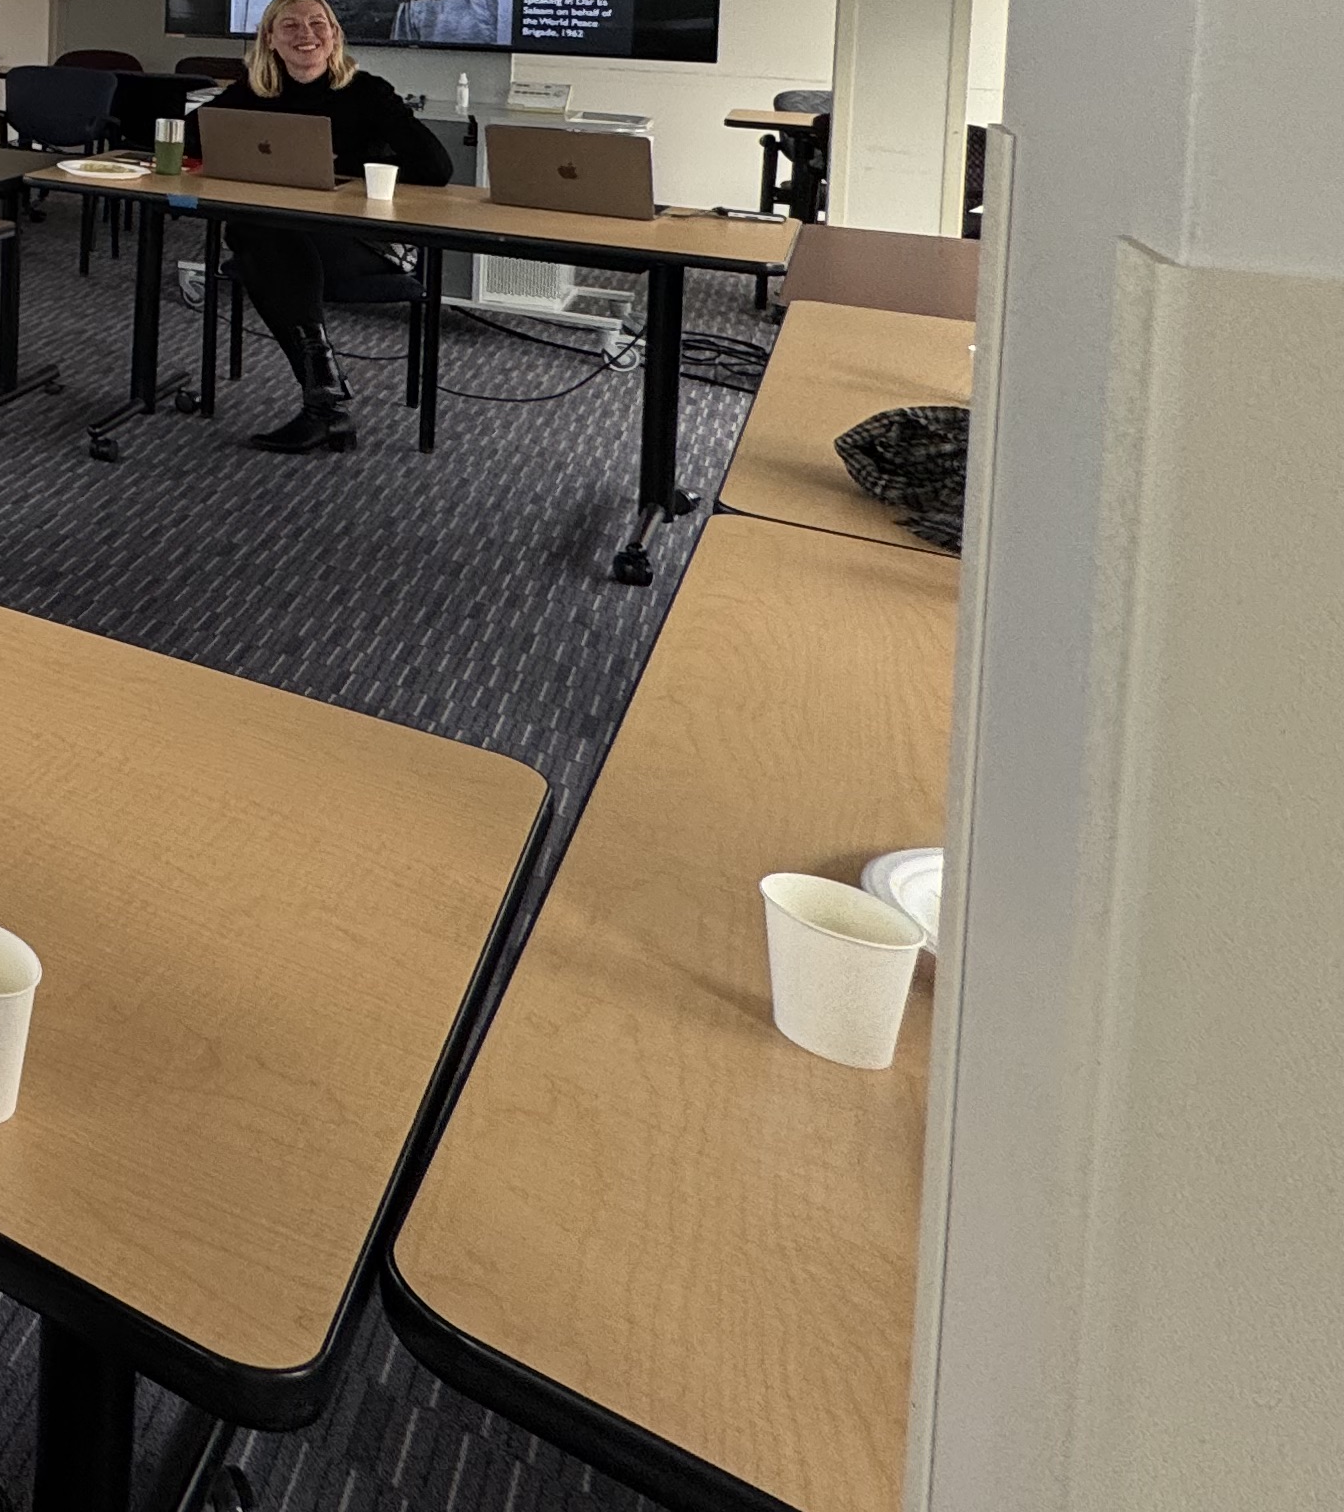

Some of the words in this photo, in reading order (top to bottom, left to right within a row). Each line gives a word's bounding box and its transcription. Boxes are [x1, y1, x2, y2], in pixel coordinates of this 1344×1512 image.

[523, 6, 554, 15] Salaam
[571, 8, 600, 17] behalf
[601, 9, 613, 17] of
[522, 17, 538, 25] the
[538, 17, 569, 26] World
[571, 18, 599, 28] Peace
[561, 28, 584, 38] 1962
